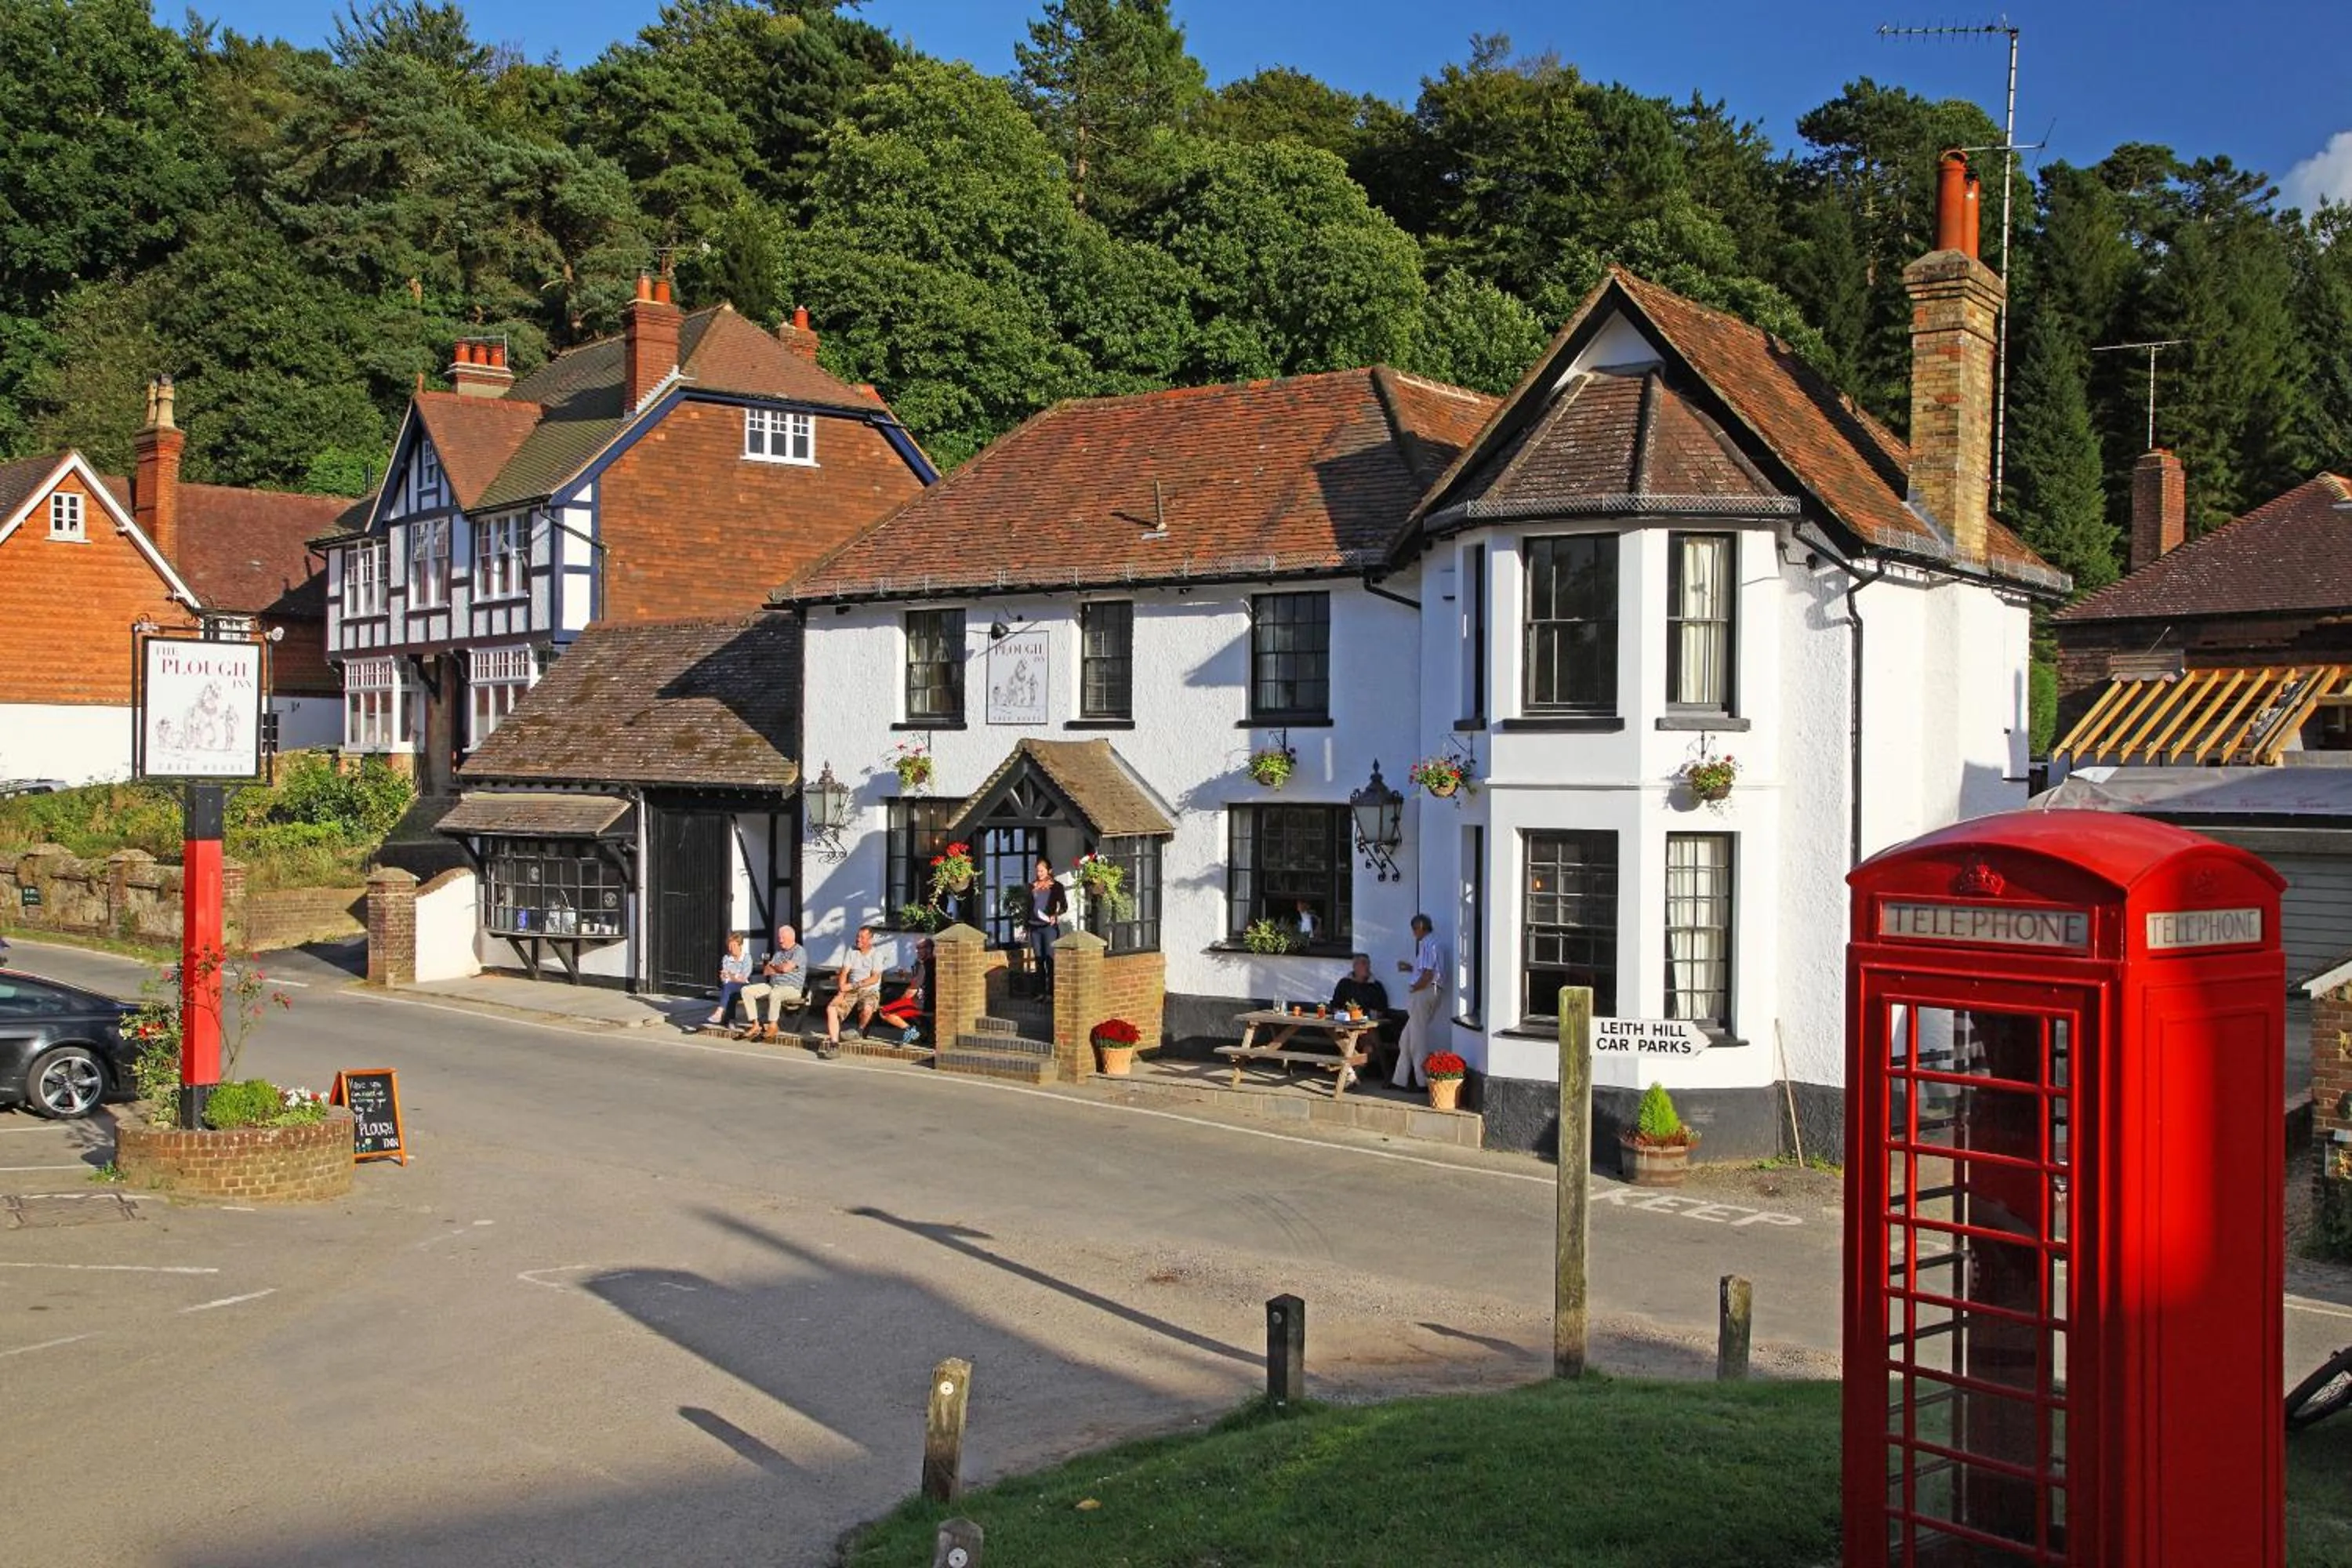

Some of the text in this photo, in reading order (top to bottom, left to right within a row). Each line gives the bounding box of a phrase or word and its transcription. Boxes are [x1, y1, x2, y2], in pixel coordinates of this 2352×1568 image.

[995, 643, 1044, 655] PLOUGH
[162, 658, 248, 677] PLOUGH
[1890, 905, 2082, 942] TELEPHONE
[2150, 911, 2257, 944] TELEPHONE
[1600, 1022, 1687, 1037] LEITH HILL
[1596, 1037, 1692, 1054] CAR PARKS
[1589, 1188, 1802, 1226] KEEP
